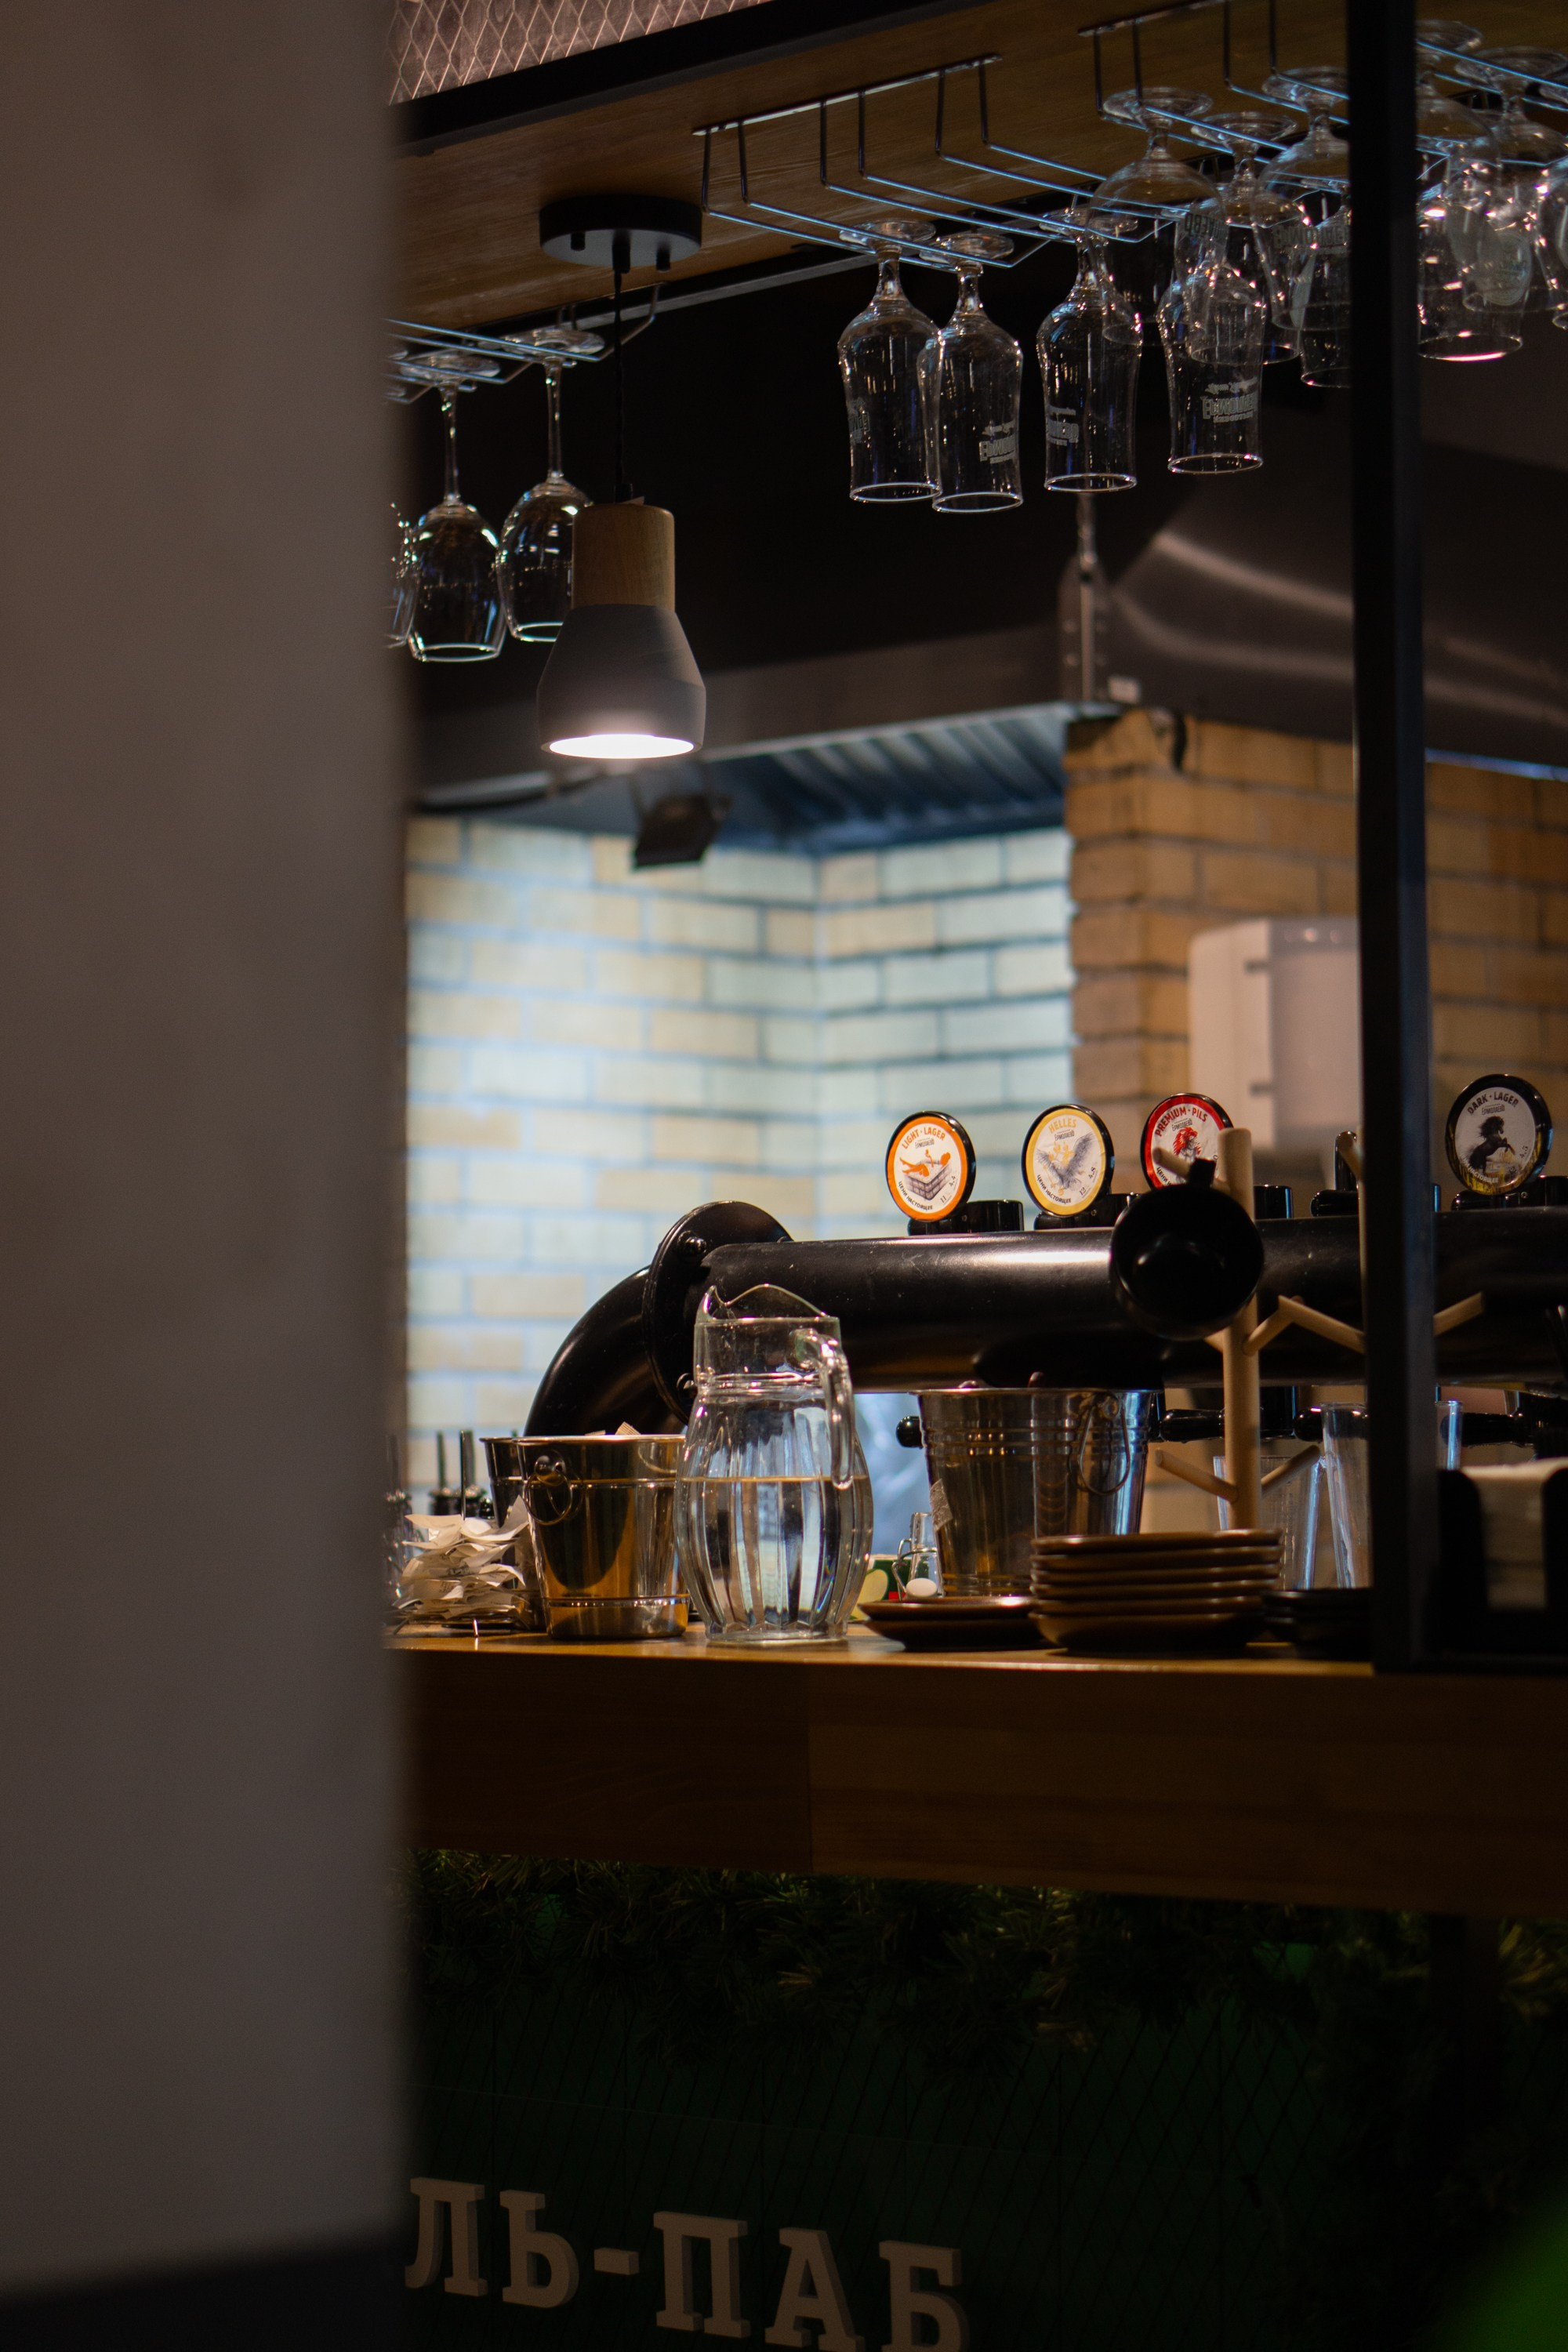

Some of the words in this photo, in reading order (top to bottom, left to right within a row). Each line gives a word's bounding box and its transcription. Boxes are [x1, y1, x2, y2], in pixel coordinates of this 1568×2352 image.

[1467, 1094, 1488, 1114] DARK
[1494, 1091, 1519, 1108] LAGER
[1048, 1118, 1076, 1134] HELLES
[1155, 1106, 1186, 1137] PREMIUM
[1192, 1107, 1207, 1122] PILS
[902, 1129, 919, 1149] LIGHT
[924, 1127, 946, 1141] LAGER
[898, 1181, 908, 1197] ЦЕНИ
[906, 1196, 933, 1211] НАСТОЯЩЕЕ
[1036, 1174, 1047, 1190] ЦЕНИ
[1046, 1189, 1071, 1204] НАСТОЯЩЕЕ
